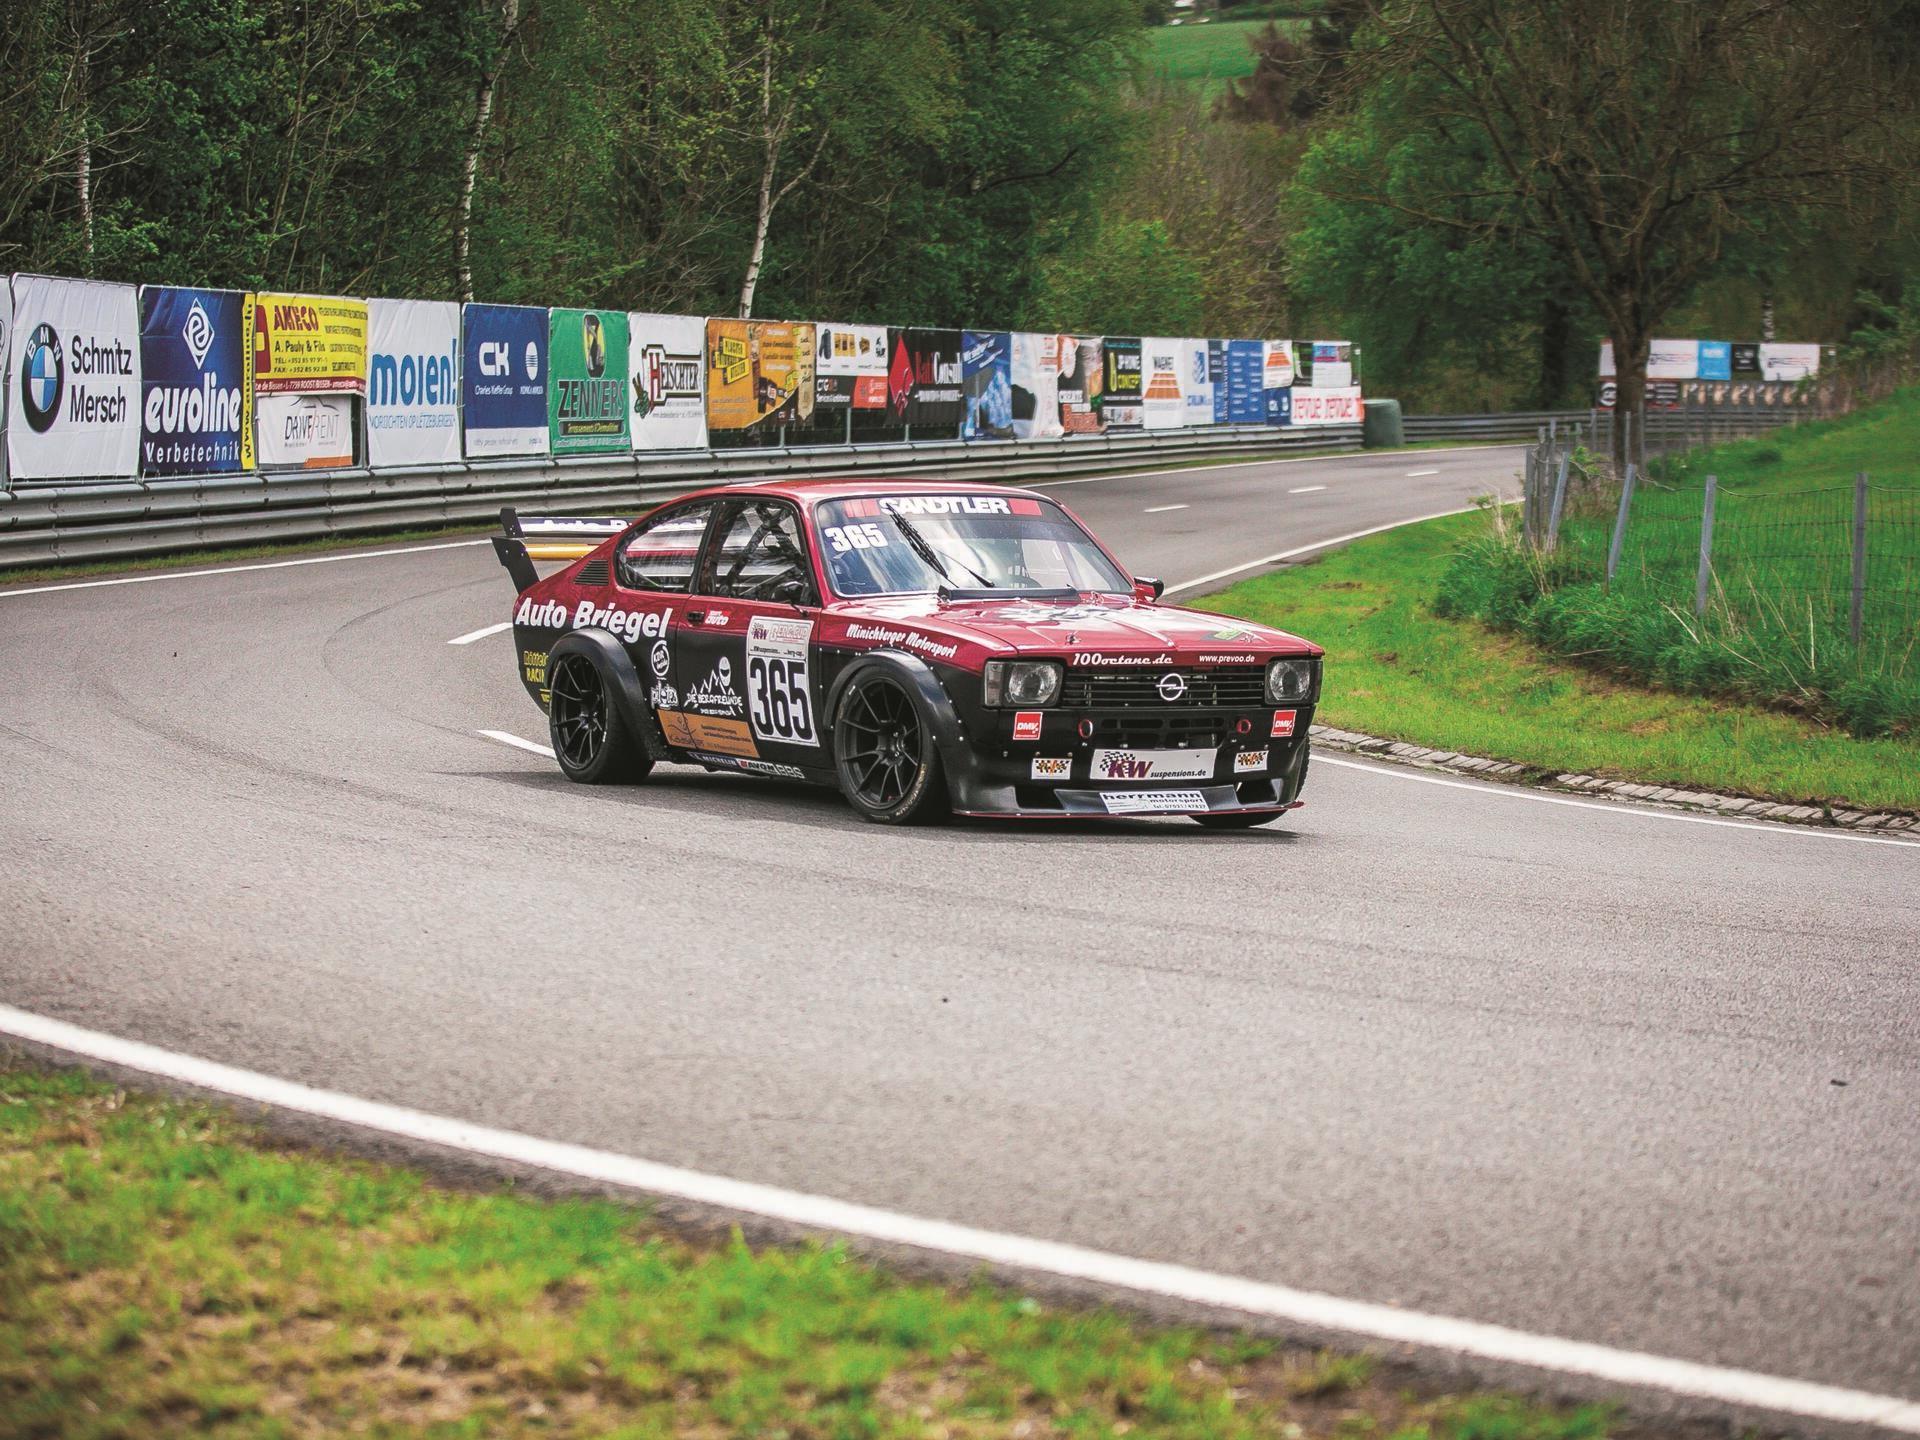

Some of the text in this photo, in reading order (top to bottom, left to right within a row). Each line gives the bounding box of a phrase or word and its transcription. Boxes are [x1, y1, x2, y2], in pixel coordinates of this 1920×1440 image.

[27, 326, 62, 362] BMW
[71, 335, 133, 375] Schmitz
[478, 341, 510, 377] CK
[648, 352, 699, 399] HEISCHTER
[70, 385, 127, 423] Mersch
[145, 372, 242, 433] euroline
[557, 379, 625, 419] ZENNERS
[878, 496, 1012, 516] SANDTLER
[824, 523, 888, 552] 365
[515, 597, 673, 643] Auto Briegel
[846, 624, 957, 658] Minichberger Motorsport
[1072, 653, 1255, 666] 100octane.de www.prevoo.de
[750, 657, 813, 740] 365
[1016, 722, 1039, 730] DMV
[1275, 720, 1293, 728] DMV
[702, 755, 737, 767] MICHELIN
[1107, 761, 1207, 779] KW suspensions.de
[1102, 792, 1201, 800] herrmann
